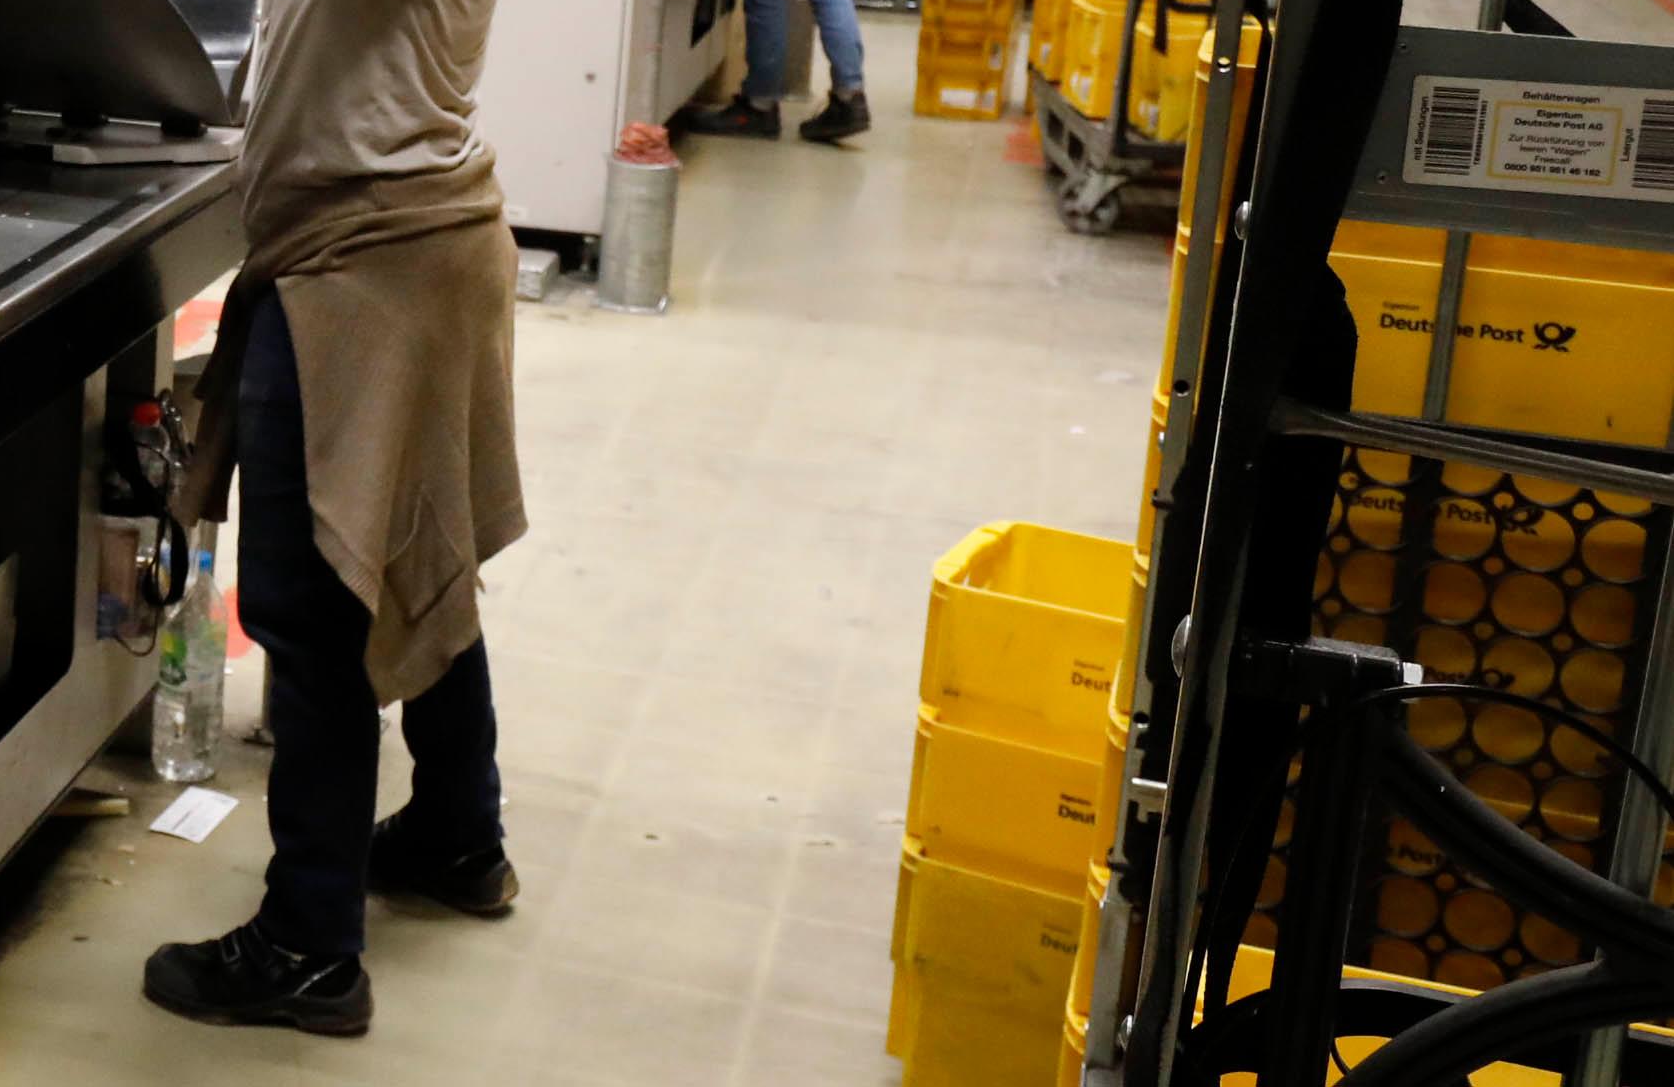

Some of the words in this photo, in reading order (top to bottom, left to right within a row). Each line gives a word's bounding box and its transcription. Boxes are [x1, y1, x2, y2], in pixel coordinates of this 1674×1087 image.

[1522, 91, 1601, 105] Behälterwagen
[1536, 109, 1584, 122] Eigentum
[1513, 117, 1559, 130] Deutsche
[1563, 120, 1586, 131] Post
[1588, 122, 1604, 132] AG
[1479, 323, 1525, 344] Post
[1070, 671, 1112, 692] Deut
